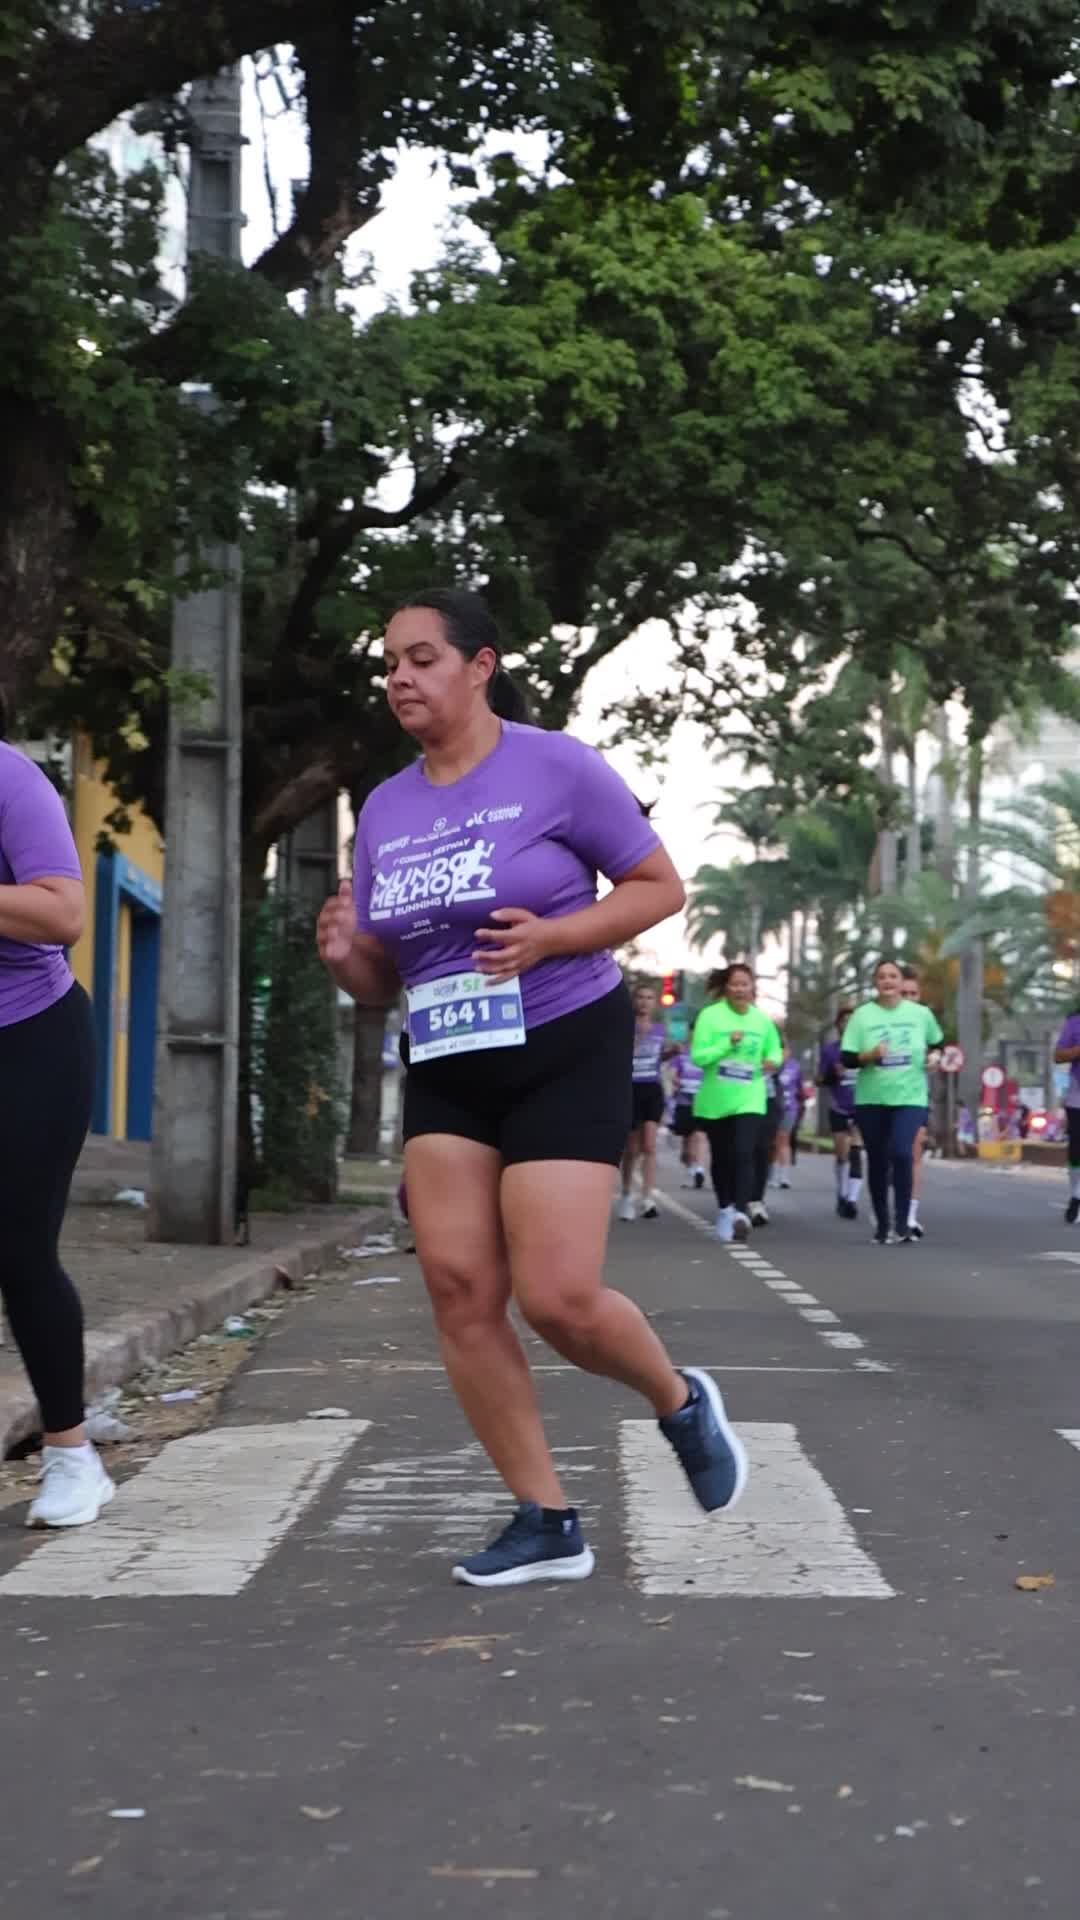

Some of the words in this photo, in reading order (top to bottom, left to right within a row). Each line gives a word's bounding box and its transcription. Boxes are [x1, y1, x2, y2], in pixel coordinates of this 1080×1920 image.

[375, 853, 471, 889] MUNDO
[370, 873, 471, 909] MELHOR
[395, 897, 441, 917] RUNNING
[429, 999, 490, 1031] 5641
